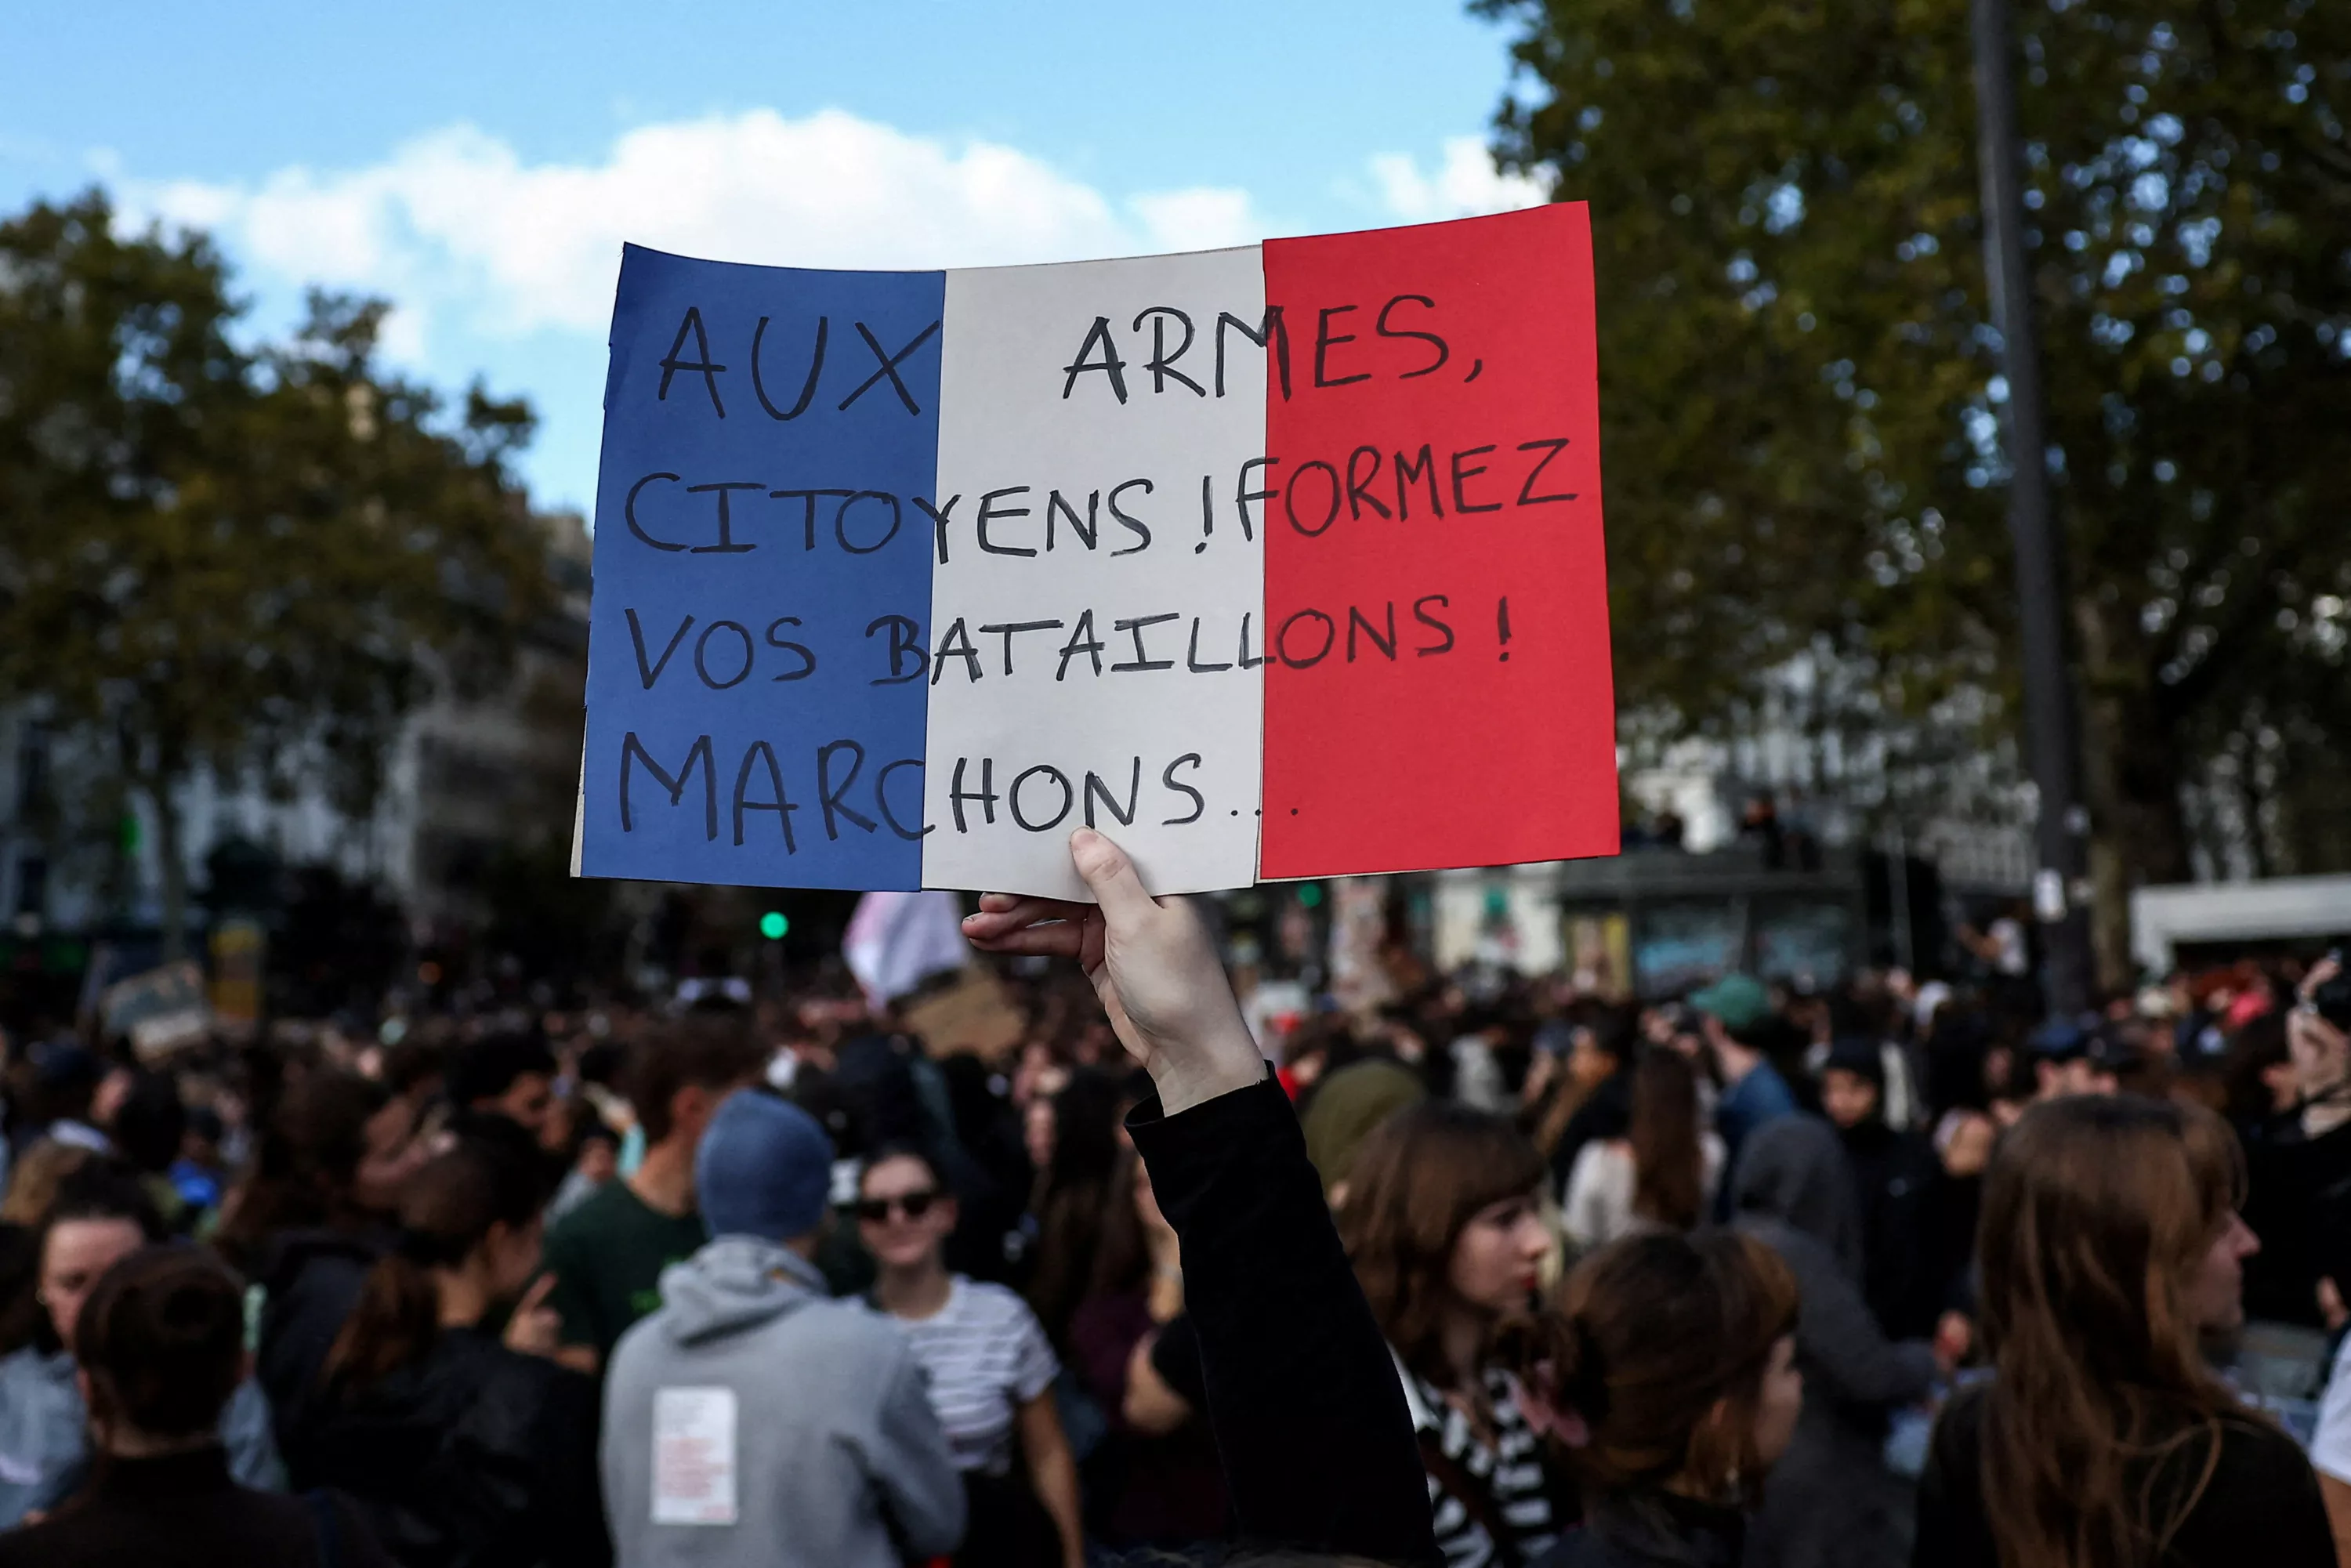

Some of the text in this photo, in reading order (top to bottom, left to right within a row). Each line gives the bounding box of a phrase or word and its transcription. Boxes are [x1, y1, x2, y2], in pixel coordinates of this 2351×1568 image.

[658, 294, 1483, 421] AUX ARMES,
[625, 471, 1154, 565] CITOYENS
[624, 607, 816, 690] VOS
[864, 593, 1455, 687] BATAILLONS
[619, 730, 1299, 856] MARCHONS...
